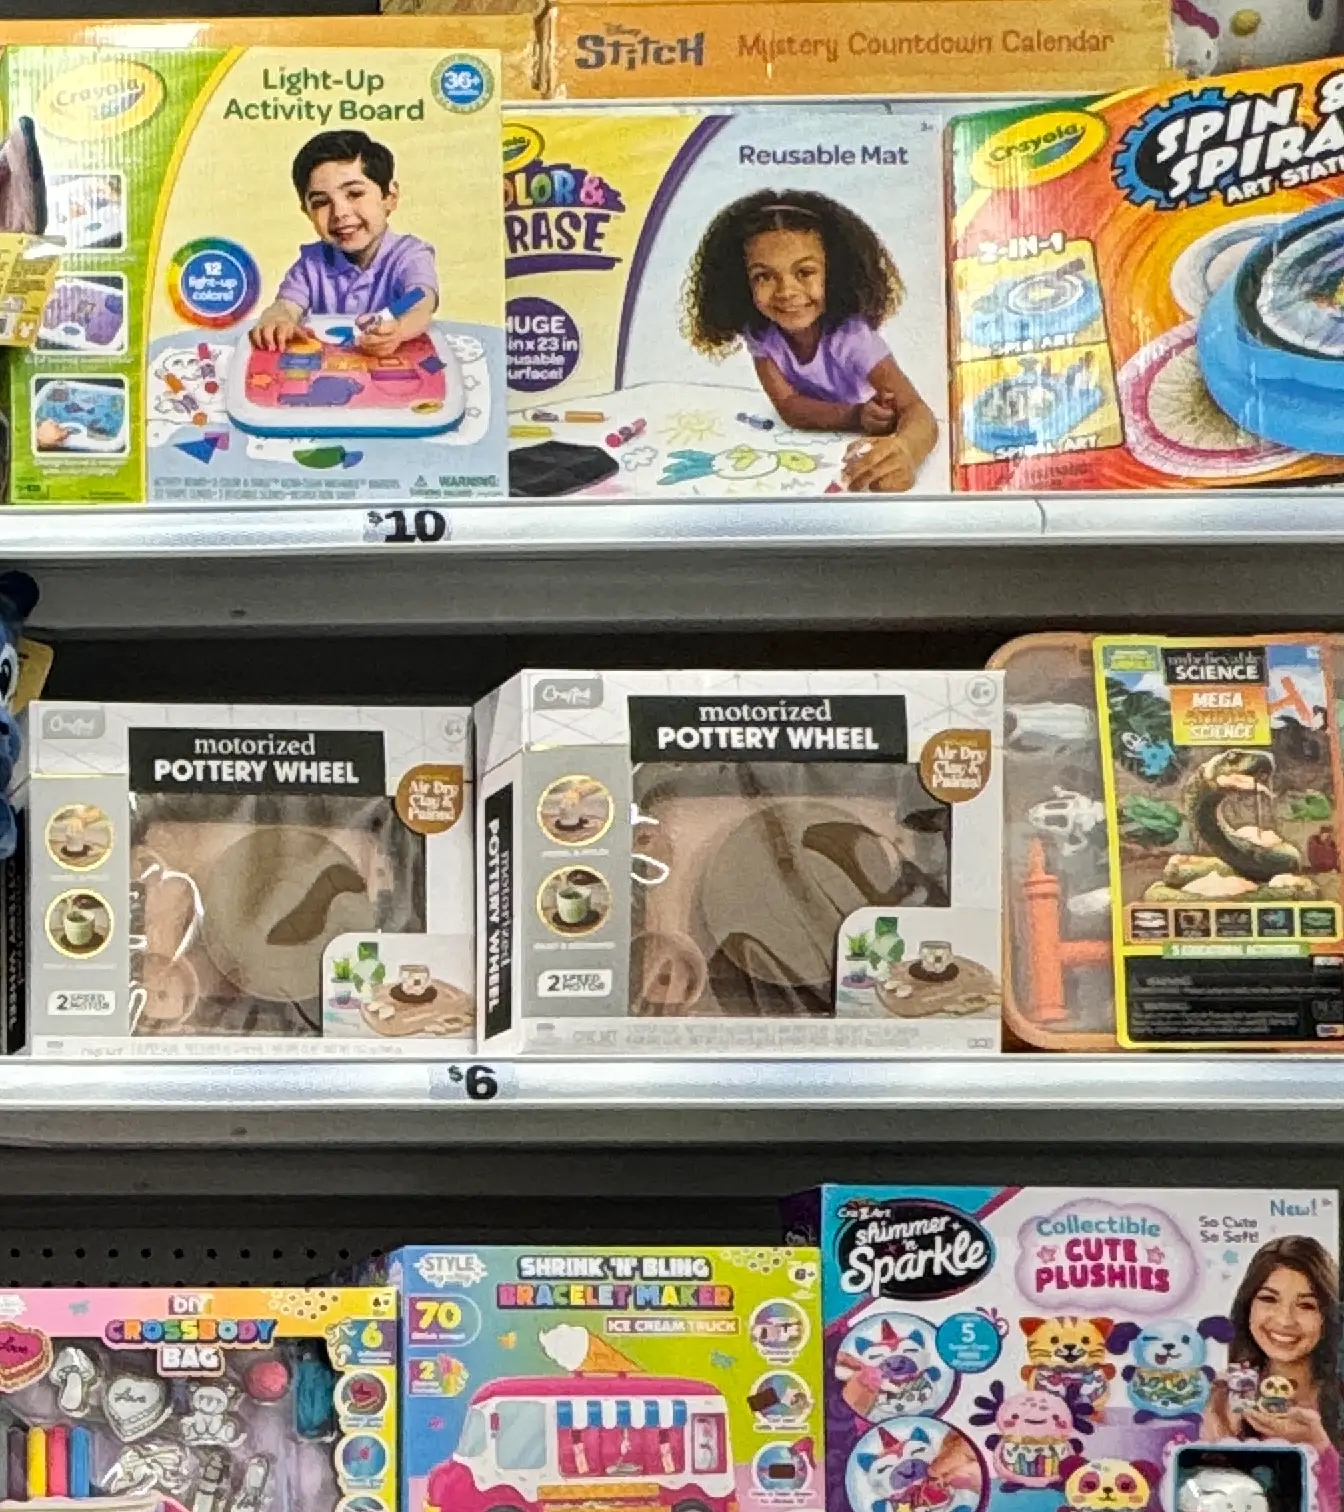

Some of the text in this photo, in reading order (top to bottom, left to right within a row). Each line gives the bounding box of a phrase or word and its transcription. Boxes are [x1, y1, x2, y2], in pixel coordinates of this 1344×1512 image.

[738, 33, 838, 63] Mystery
[848, 31, 993, 55] Countdown
[1001, 29, 1113, 53] Calendar
[55, 77, 141, 107] Crayola
[263, 67, 384, 96] Light-Up
[223, 98, 424, 125] Activity Board
[1156, 86, 1302, 165] SPIN
[739, 144, 909, 165] Reusable Mat
[989, 121, 1086, 164] Crayola
[1167, 112, 1344, 200] SPIRA
[504, 169, 576, 208] OLOR
[1225, 154, 1344, 205] ART STATI
[505, 210, 612, 254] RASE
[508, 367, 563, 381] urface!
[367, 509, 446, 543] $10
[1175, 665, 1259, 681] SCIENCE
[699, 700, 832, 723] motorized
[1192, 692, 1244, 708] MEGA
[194, 733, 316, 757] motorized
[657, 726, 879, 750] POTTERY WHEEL
[932, 745, 985, 765] Air Dry
[153, 758, 360, 785] POTTERY WHEEL
[548, 975, 560, 991] 2
[56, 994, 68, 1012] 2
[448, 1064, 499, 1101] $6
[1270, 1198, 1319, 1218] New!
[856, 1216, 948, 1248] shimmer
[1036, 1215, 1161, 1238] Collectible
[424, 1256, 474, 1272] STYLE
[1065, 1238, 1138, 1264] CUTE
[519, 1257, 603, 1279] SHRINK
[641, 1257, 711, 1279] BLING
[841, 1237, 989, 1298] Sparkle
[1036, 1265, 1170, 1293] PLUSHIES
[498, 1284, 734, 1308] BRACELET MAKER
[417, 1301, 462, 1329] 70
[608, 1319, 737, 1333] ICE CREAM TRUCK
[106, 1318, 278, 1344] CROSSBODY
[960, 1323, 976, 1342] 5
[161, 1347, 220, 1370] BAG
